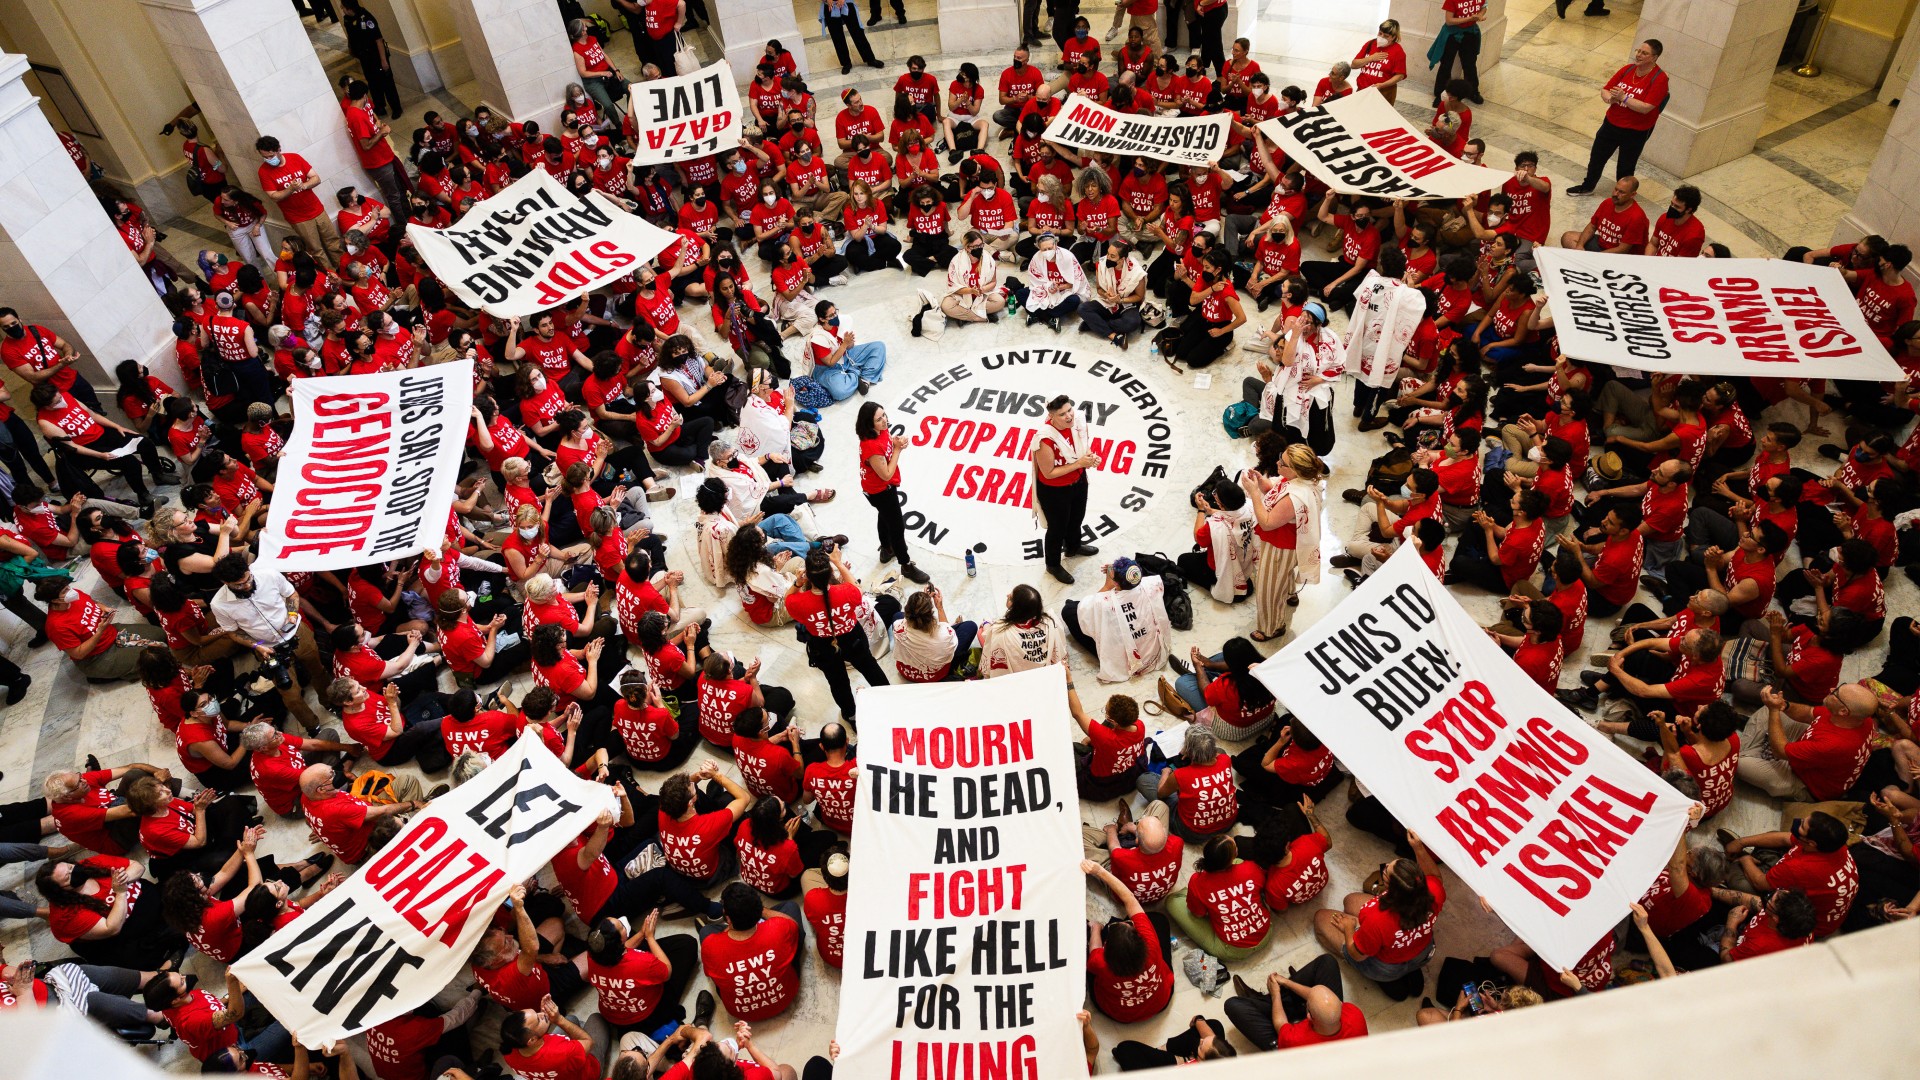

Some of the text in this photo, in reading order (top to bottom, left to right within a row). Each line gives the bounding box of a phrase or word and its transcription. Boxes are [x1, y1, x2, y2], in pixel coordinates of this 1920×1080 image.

[1463, 5, 1481, 14] OUR
[1617, 82, 1633, 91] NOT
[649, 73, 723, 123] LIVE
[646, 110, 732, 150] GAZA
[850, 127, 867, 136] OUR
[1068, 103, 1220, 150] CEASEFIRE NOW
[1278, 106, 1444, 198] ASEFIRE
[1361, 127, 1455, 180] NOW
[276, 170, 304, 184] NOT IN
[689, 162, 710, 172] STOP
[690, 168, 714, 177] ARMING
[609, 178, 625, 191] OUR
[735, 183, 746, 194] NOT
[740, 183, 754, 196] OUR
[1132, 191, 1145, 200] NOT
[1133, 198, 1152, 206] OUR
[978, 208, 1002, 216] STOP
[918, 221, 938, 229] OUR
[978, 220, 1005, 229] ISRAEL
[1039, 220, 1059, 228] OUR
[1601, 218, 1621, 232] STOP
[1659, 230, 1671, 241] NOT
[462, 195, 613, 304] ARMING
[1264, 256, 1282, 266] OUR
[535, 241, 636, 305] STOP
[785, 274, 797, 285] NOT
[651, 296, 671, 317] NOT IN
[1560, 268, 1618, 342] JEWS TO
[1864, 296, 1881, 313] OUR
[1867, 287, 1891, 309] NOT IN
[659, 303, 674, 319] OUR
[1602, 270, 1672, 360] CONGRESS
[1659, 287, 1726, 345] STOP
[1708, 276, 1800, 364] ARMING
[1771, 286, 1862, 358] ISRAEL
[24, 343, 40, 360] NOT
[540, 346, 564, 357] NOT IN
[544, 355, 562, 363] OUR
[981, 349, 1078, 370] UNTIL
[399, 376, 443, 424] JEWS
[605, 382, 621, 401] STOP
[898, 364, 972, 415] FREE
[540, 399, 553, 413] NOT
[548, 399, 564, 416] OUR
[960, 387, 1046, 418] JEWS
[58, 406, 81, 428] NOT IN
[68, 414, 87, 430] OUR
[655, 412, 667, 430] NOT
[1088, 359, 1171, 479] EVERYONE
[912, 415, 997, 454] STOP
[276, 392, 391, 559] GENOCIDE
[942, 463, 1032, 509] ISRA
[384, 467, 434, 516] STOP
[1120, 486, 1154, 512] IS
[368, 516, 421, 557] THE
[616, 582, 640, 605] JEWS
[80, 601, 94, 626] STOP
[1305, 583, 1436, 696] JEWS TO
[1027, 648, 1043, 657] FOR
[702, 682, 735, 700] JEWS
[701, 704, 732, 720] STOP
[702, 694, 730, 711] SAY
[618, 718, 656, 731] JEWS
[622, 729, 651, 740] SAY
[1404, 679, 1508, 784] STOP
[447, 730, 489, 742] JEWS
[892, 719, 1034, 770] MOURN
[452, 742, 484, 754] SAY
[735, 747, 767, 768] JEWS
[738, 759, 762, 777] SAY
[1698, 752, 1738, 779] JEWS
[810, 778, 853, 789] JEWS
[1192, 768, 1231, 789] JEWS
[1705, 766, 1734, 789] SAY
[814, 789, 848, 800] SAY
[866, 764, 1064, 820] THE DEAD,
[1197, 793, 1234, 810] STOP
[1199, 781, 1231, 801] SAY
[1435, 717, 1589, 868] ARMING
[466, 758, 583, 848] LET
[661, 830, 701, 847] JEWS
[934, 825, 1000, 864] AND
[1503, 774, 1658, 918] ISRAEL
[664, 843, 696, 858] SAY
[738, 838, 776, 864] JEWS
[740, 850, 768, 872] SAY
[364, 816, 506, 948] GAZA
[1130, 862, 1176, 882] JEWS
[1286, 856, 1321, 898] JEWS
[908, 864, 1027, 921] FIGHT
[1136, 874, 1172, 892] SAY
[1208, 880, 1255, 904] JEWS
[1218, 894, 1252, 914] SAY
[1221, 903, 1258, 923] STOP
[1226, 917, 1268, 941] ISRAEL
[863, 919, 1067, 979] LIKE HELL
[1577, 941, 1614, 970] JEWS
[264, 897, 424, 1031] LIVE
[726, 950, 775, 974] JEWS
[591, 974, 635, 989] JEWS
[734, 965, 772, 986] SAY
[1113, 964, 1157, 989] JEWS
[597, 988, 630, 999] SAY
[734, 977, 777, 996] STOP
[735, 983, 784, 1005] ARMING
[736, 992, 786, 1012] ISRAEL
[896, 982, 1034, 1030] FOR THE
[890, 1034, 1038, 1080] LIVING
